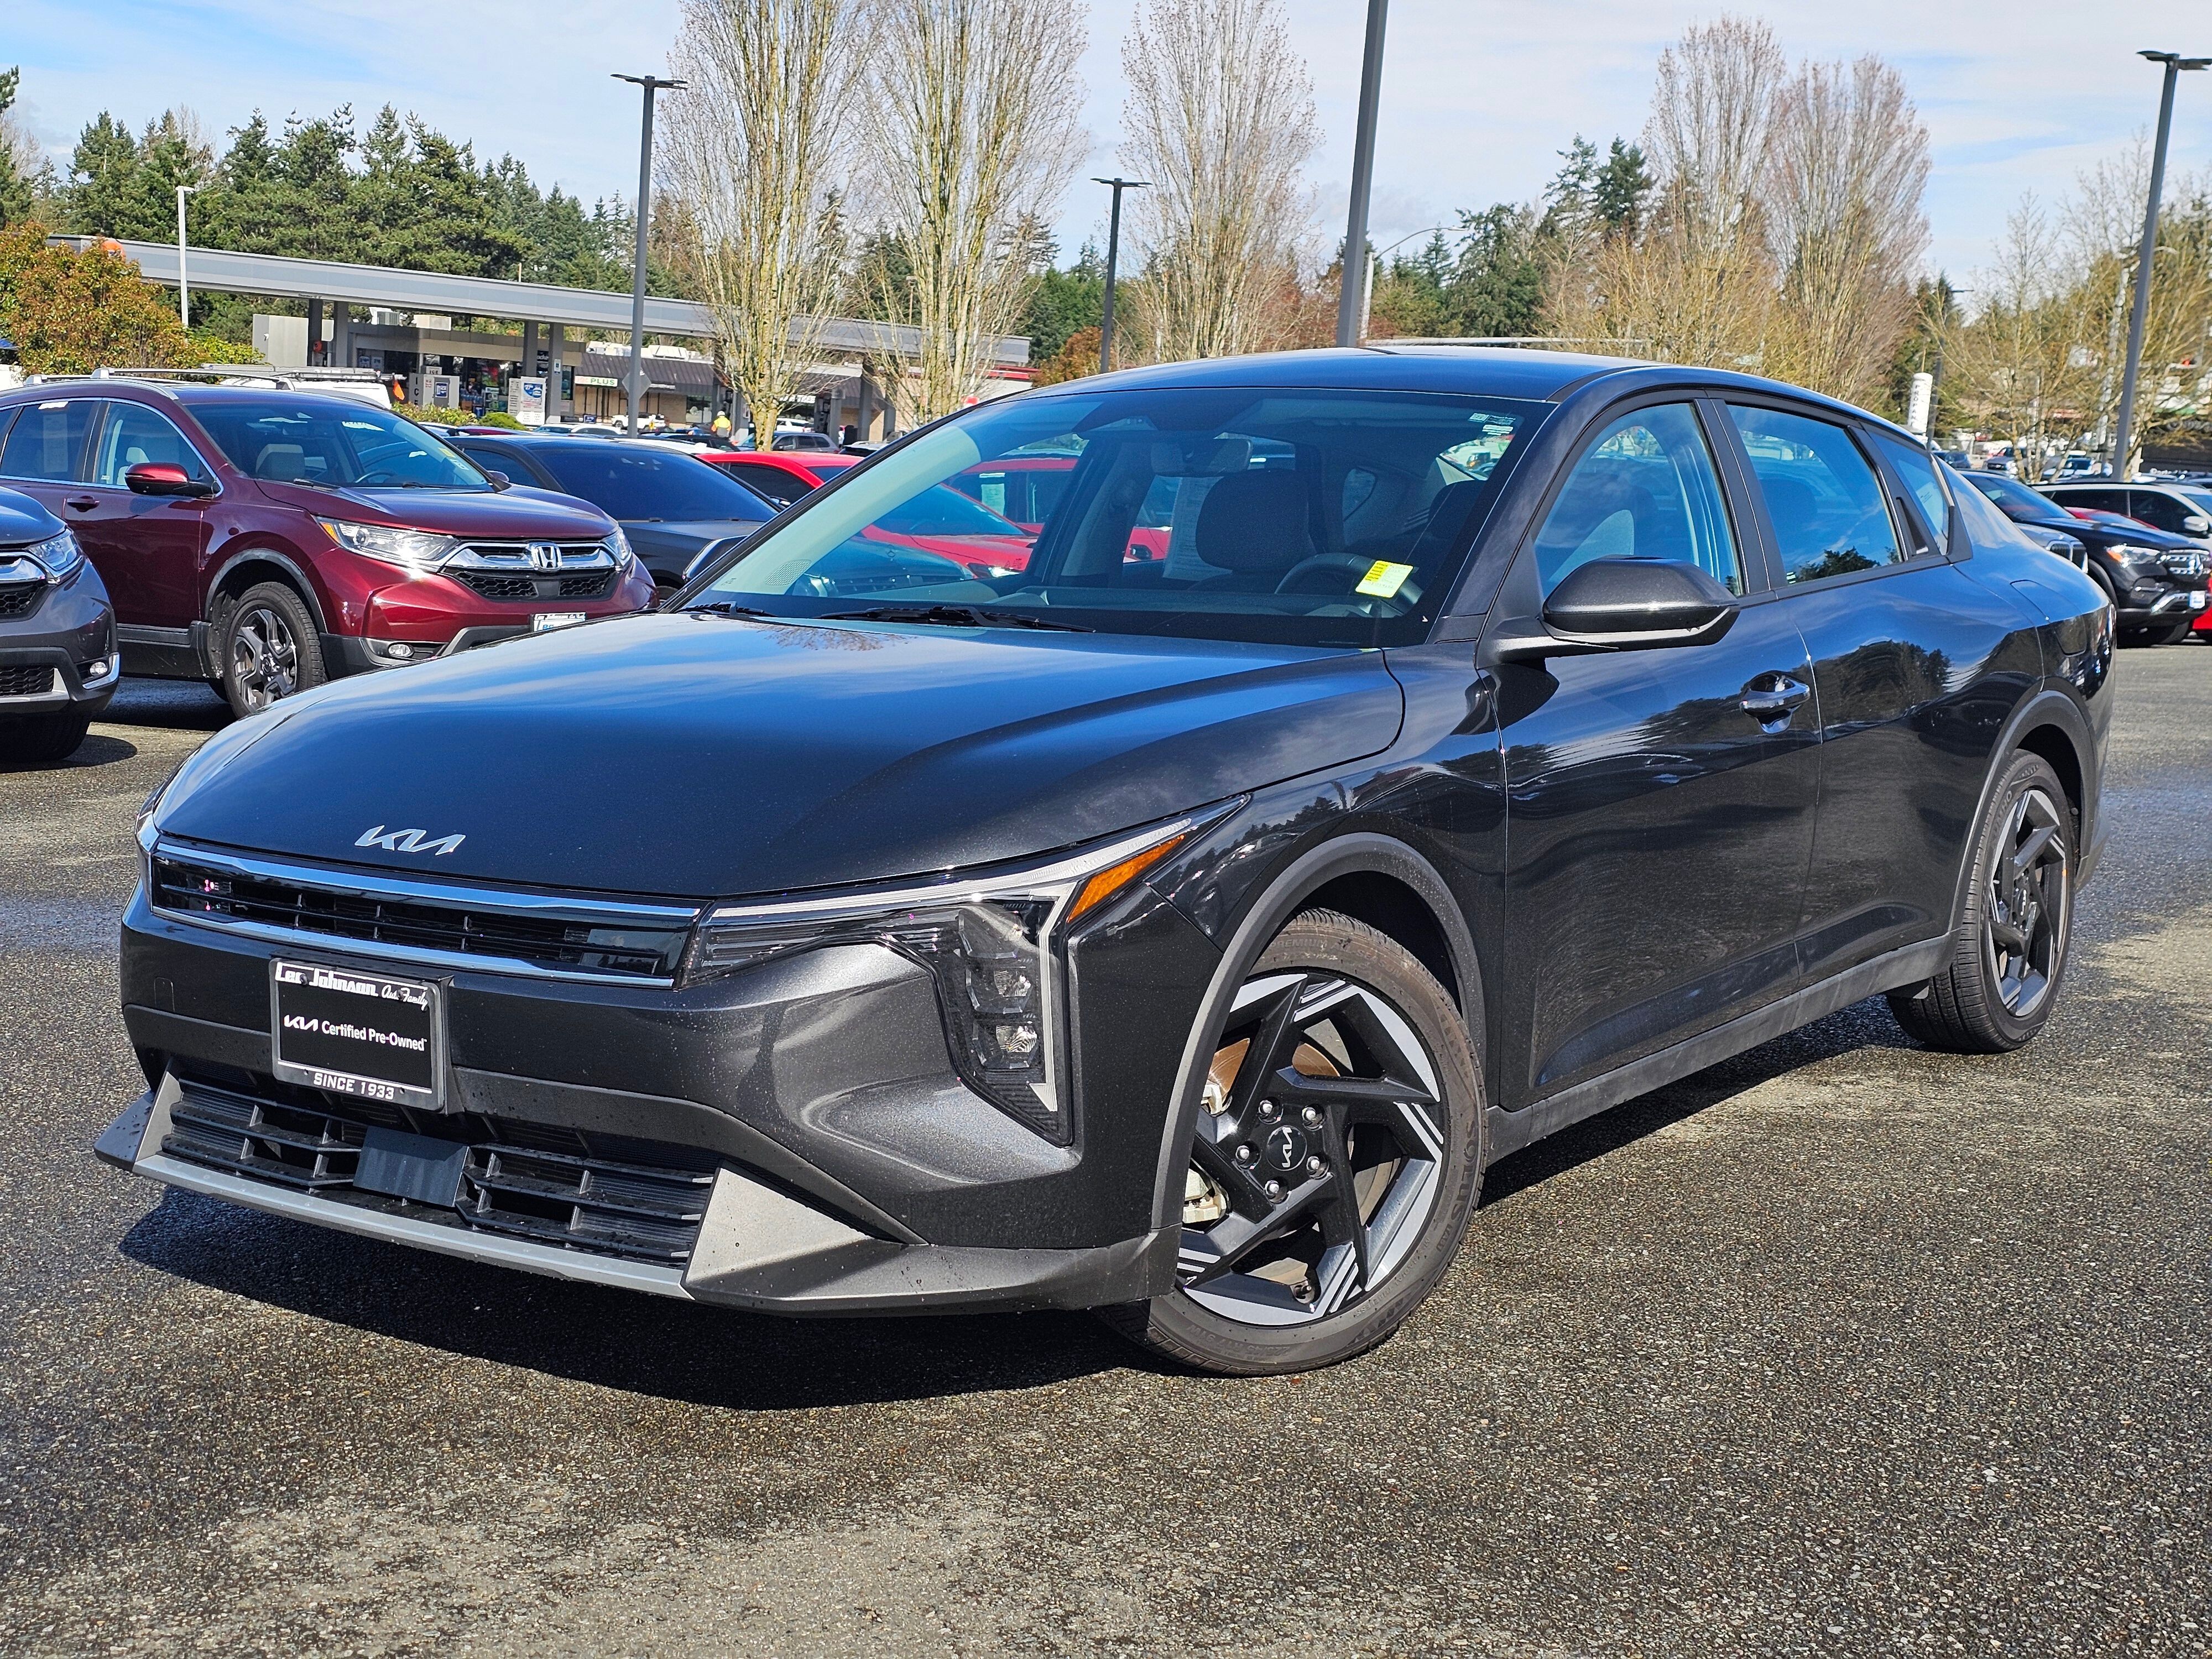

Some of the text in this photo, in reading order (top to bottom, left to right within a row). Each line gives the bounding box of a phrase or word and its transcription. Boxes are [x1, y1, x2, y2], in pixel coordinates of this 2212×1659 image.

[354, 825, 466, 856] KIA
[309, 968, 378, 997] Johnson
[400, 987, 428, 1011] Family
[284, 1014, 319, 1032] KIA
[321, 1020, 367, 1041] Certified
[314, 1072, 394, 1100] SINCE 1933
[1281, 1126, 1292, 1167] KIA
[1451, 1120, 1476, 1221] SOLUS
